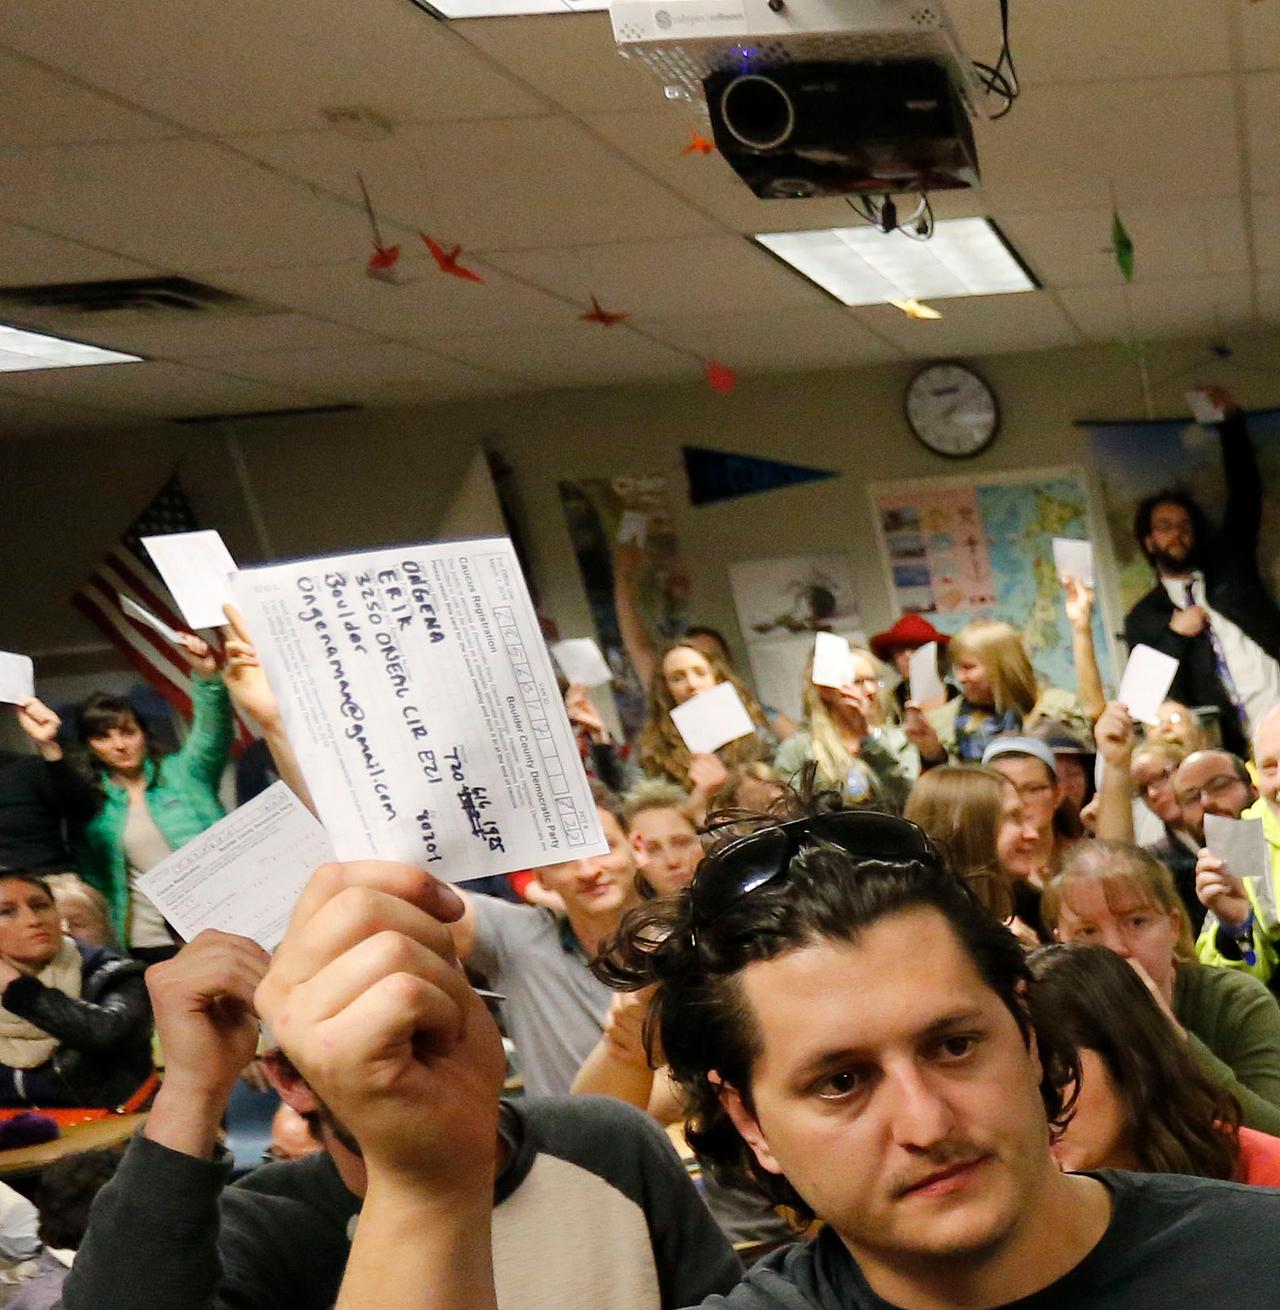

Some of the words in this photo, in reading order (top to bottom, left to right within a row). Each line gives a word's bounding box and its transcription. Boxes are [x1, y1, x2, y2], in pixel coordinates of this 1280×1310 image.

[376, 570, 415, 631] ERIK
[400, 560, 446, 643] ONGENA
[457, 556, 477, 592] Caucus
[471, 595, 499, 653] Registration
[354, 572, 383, 625] 3250
[401, 706, 428, 740] CIR
[505, 696, 525, 732] Boulder
[516, 735, 536, 768] County
[529, 771, 553, 822] Democratic
[544, 824, 561, 848] Party
